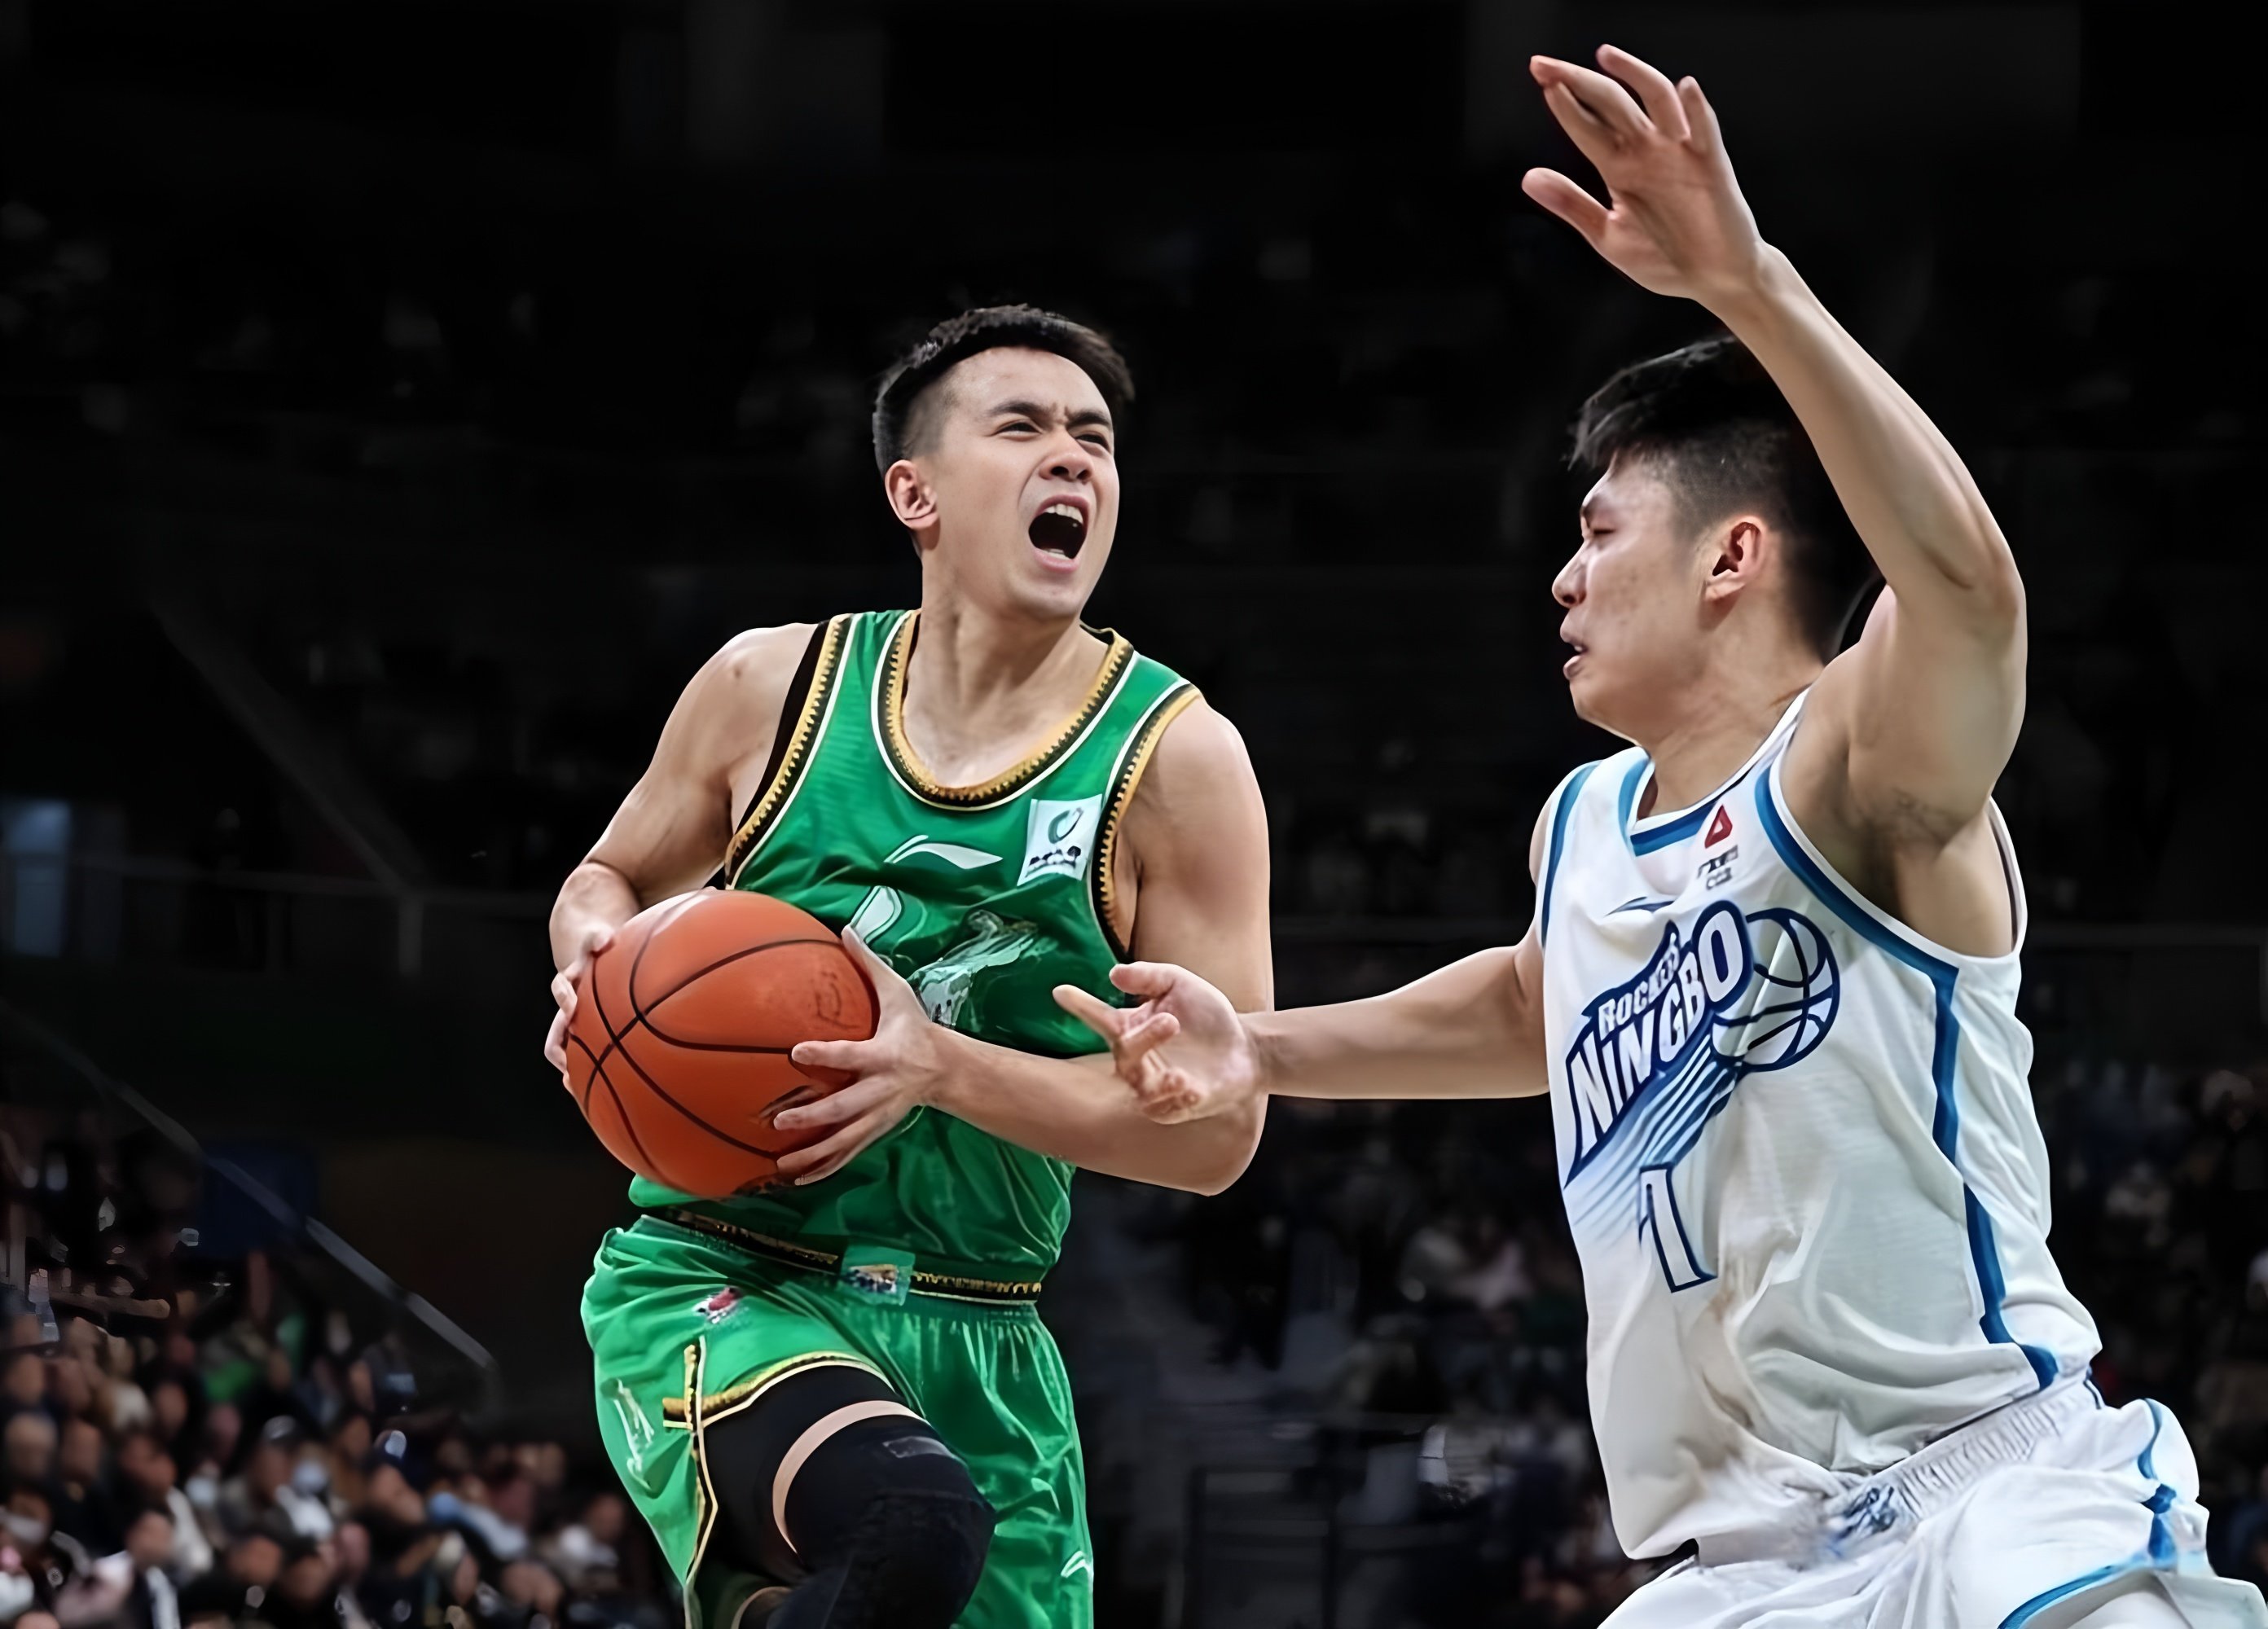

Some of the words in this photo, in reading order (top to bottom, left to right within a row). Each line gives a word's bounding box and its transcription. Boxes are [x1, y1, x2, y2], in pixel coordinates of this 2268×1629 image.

[1569, 909, 1744, 1160] NINGBO
[1598, 932, 1680, 1042] ROCK
[1637, 1162, 1718, 1293] 1
